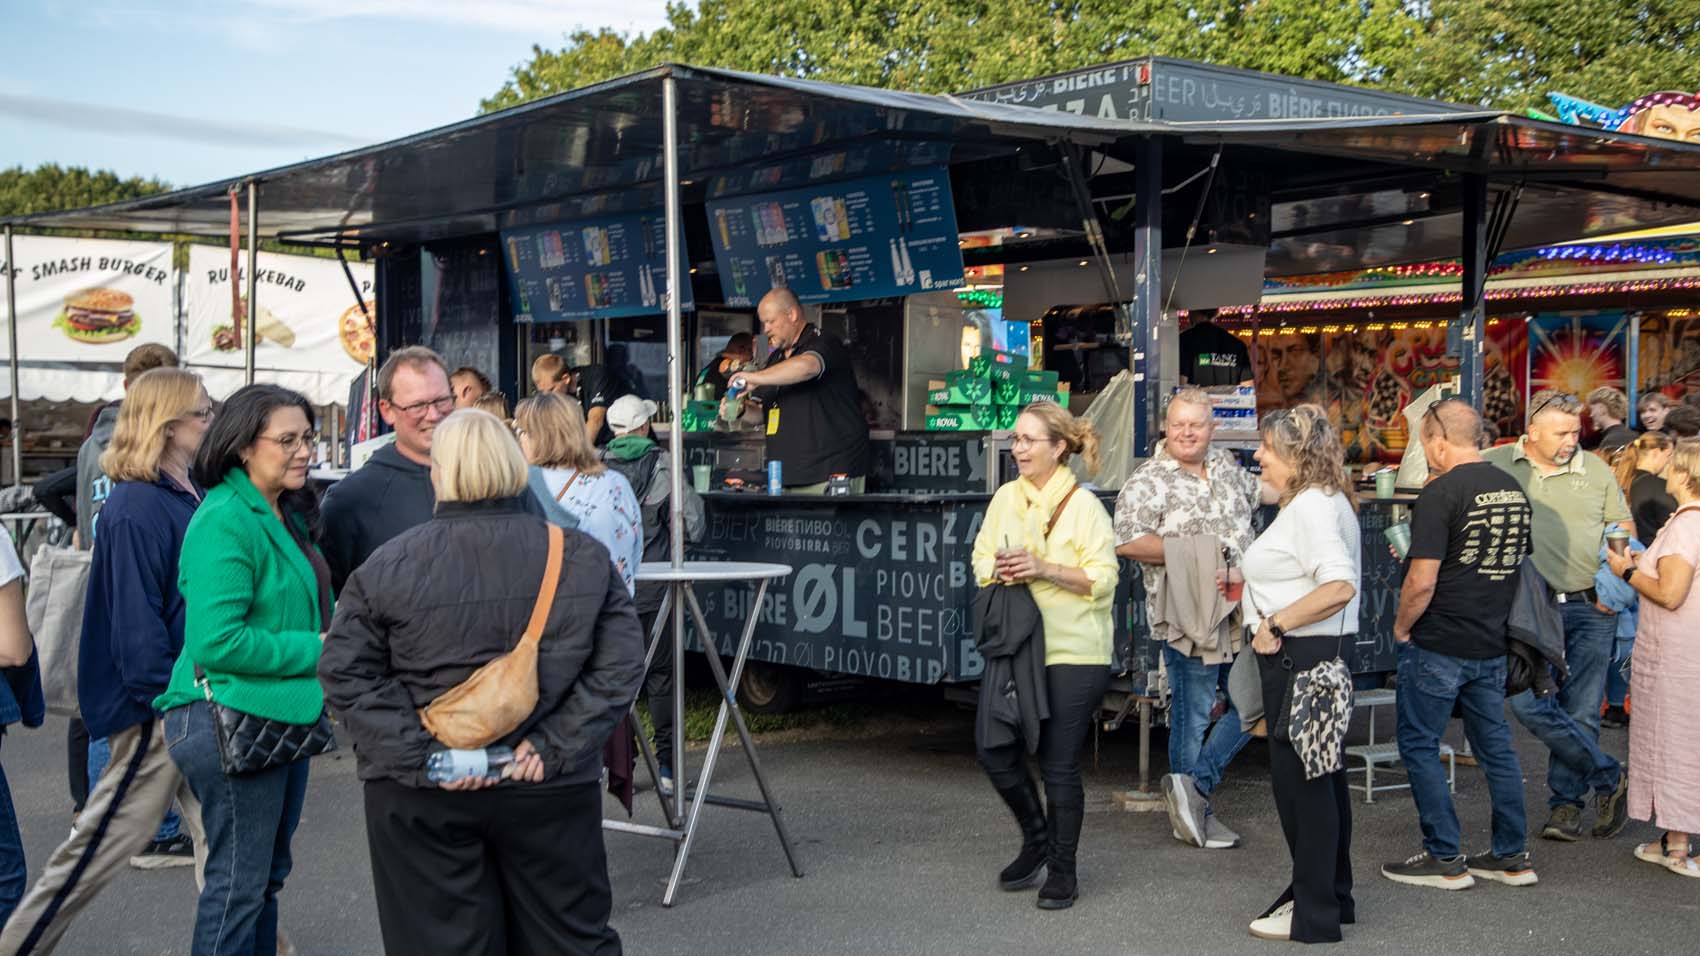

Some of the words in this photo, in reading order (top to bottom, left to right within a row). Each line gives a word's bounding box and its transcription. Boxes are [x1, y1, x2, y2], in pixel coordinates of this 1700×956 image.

[32, 257, 92, 280] SMASH
[98, 257, 167, 286] BURGER
[937, 418, 958, 427] ROYAL
[895, 440, 961, 476] BIÈRE
[793, 563, 868, 638] ØL
